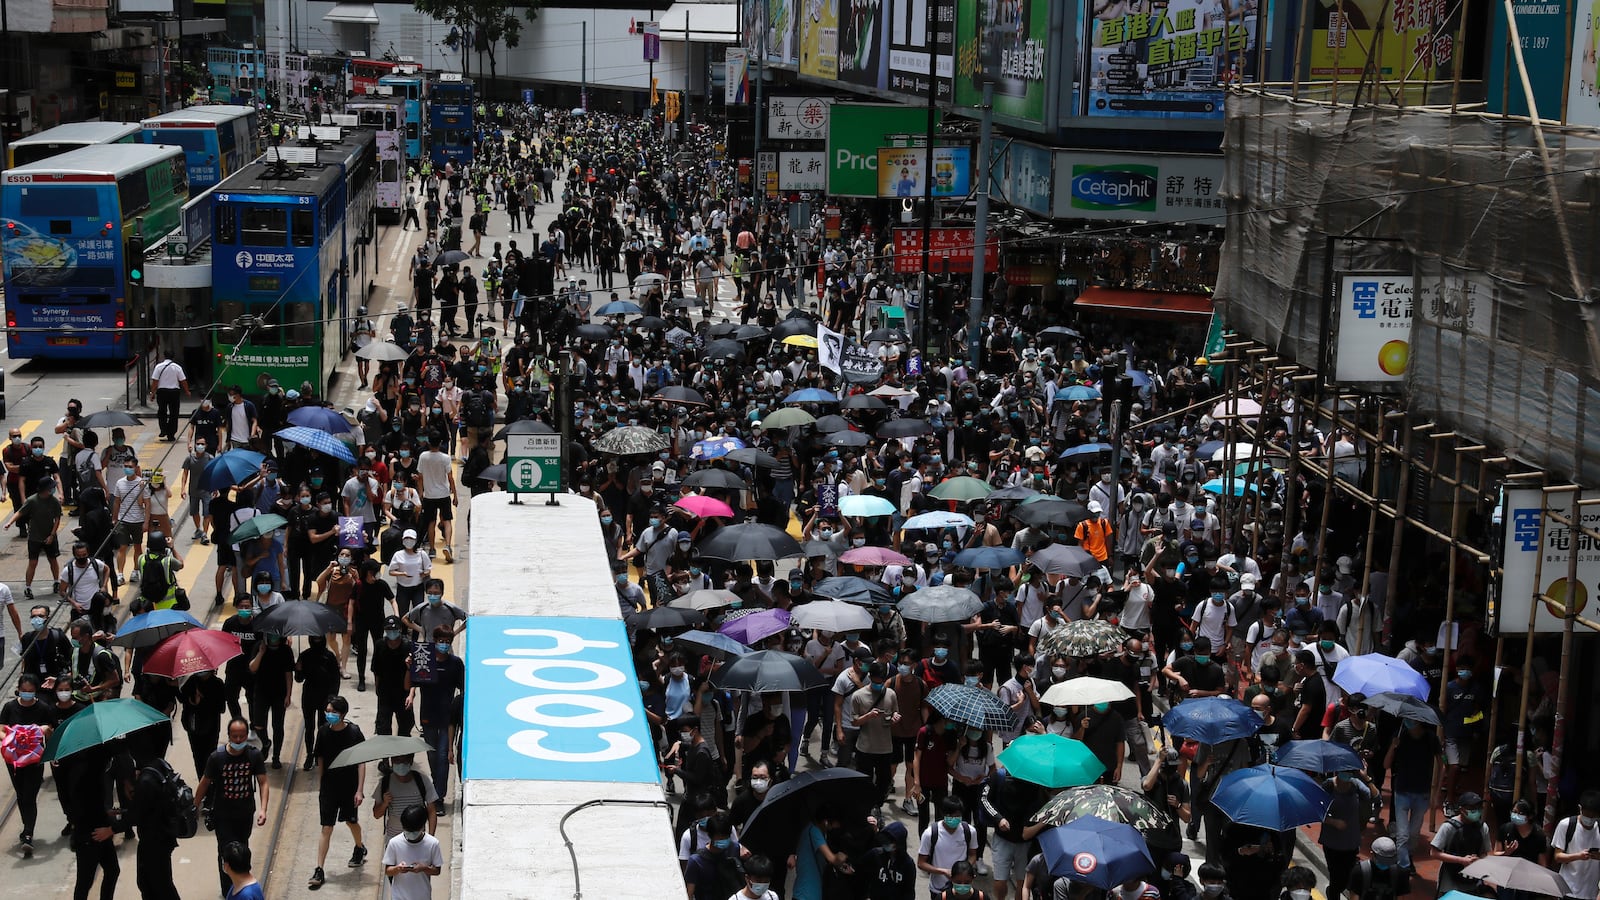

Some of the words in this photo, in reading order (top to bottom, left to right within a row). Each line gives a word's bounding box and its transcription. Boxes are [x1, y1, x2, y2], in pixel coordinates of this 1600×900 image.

[1545, 5, 1560, 14] PRESS
[1102, 8, 1196, 46] 香港人嘅
[1148, 25, 1249, 66] 直播平台
[1533, 37, 1549, 48] 1897
[1078, 178, 1150, 200] Cetaphil
[218, 194, 229, 202] 53
[299, 196, 310, 205] 53
[79, 240, 114, 249] 保護引擎
[79, 251, 114, 260] 一路如新
[481, 628, 641, 762] cody
